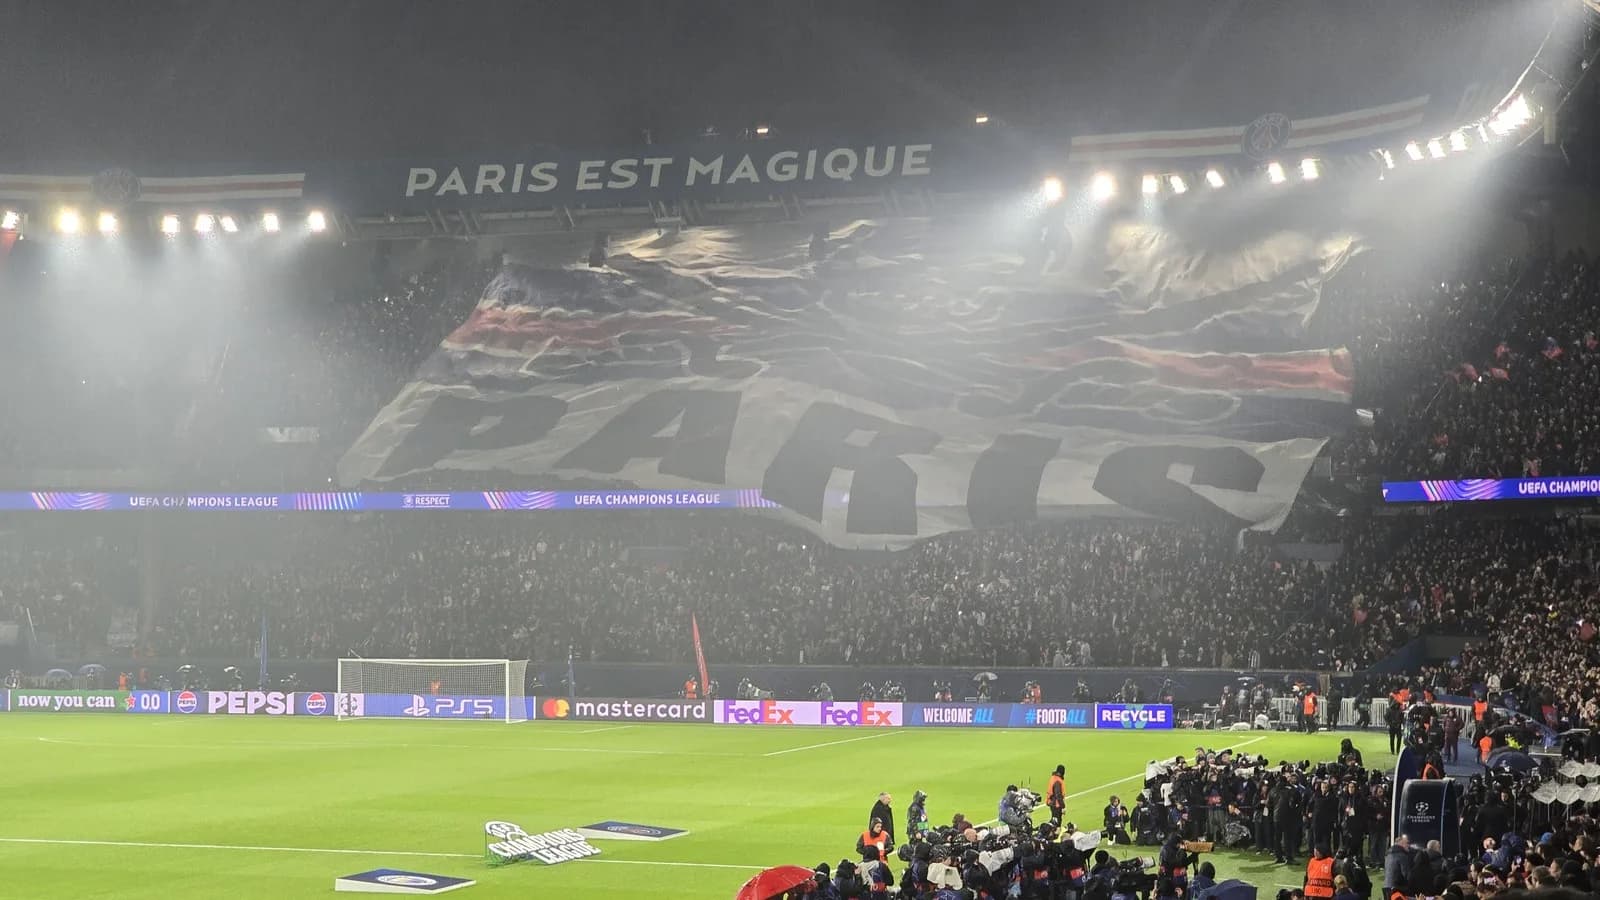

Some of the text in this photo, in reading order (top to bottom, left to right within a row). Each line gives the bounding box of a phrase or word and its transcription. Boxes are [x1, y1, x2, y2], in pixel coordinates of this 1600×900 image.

[405, 143, 933, 197] PARIS EST MAGIQUE
[378, 388, 1266, 536] PARIS
[1518, 480, 1600, 494] UEFA CHAMPIO
[130, 496, 159, 507] UEFA
[234, 496, 279, 507] LEAGUE
[415, 496, 450, 505] RESPECT
[574, 493, 720, 505] UEFA CHAMPIONS LEAGUE
[18, 695, 115, 711] now you can
[208, 691, 295, 715] PEPSI
[435, 698, 494, 715] PS5
[575, 700, 706, 719] mastercard
[723, 699, 795, 725] FedEx
[820, 700, 893, 726] FedEx
[923, 707, 995, 725] WELCOME ALL
[1025, 708, 1088, 725] #FOOTBALL
[1101, 709, 1166, 723] RECYCLE
[488, 828, 586, 857] CHAMPIONS
